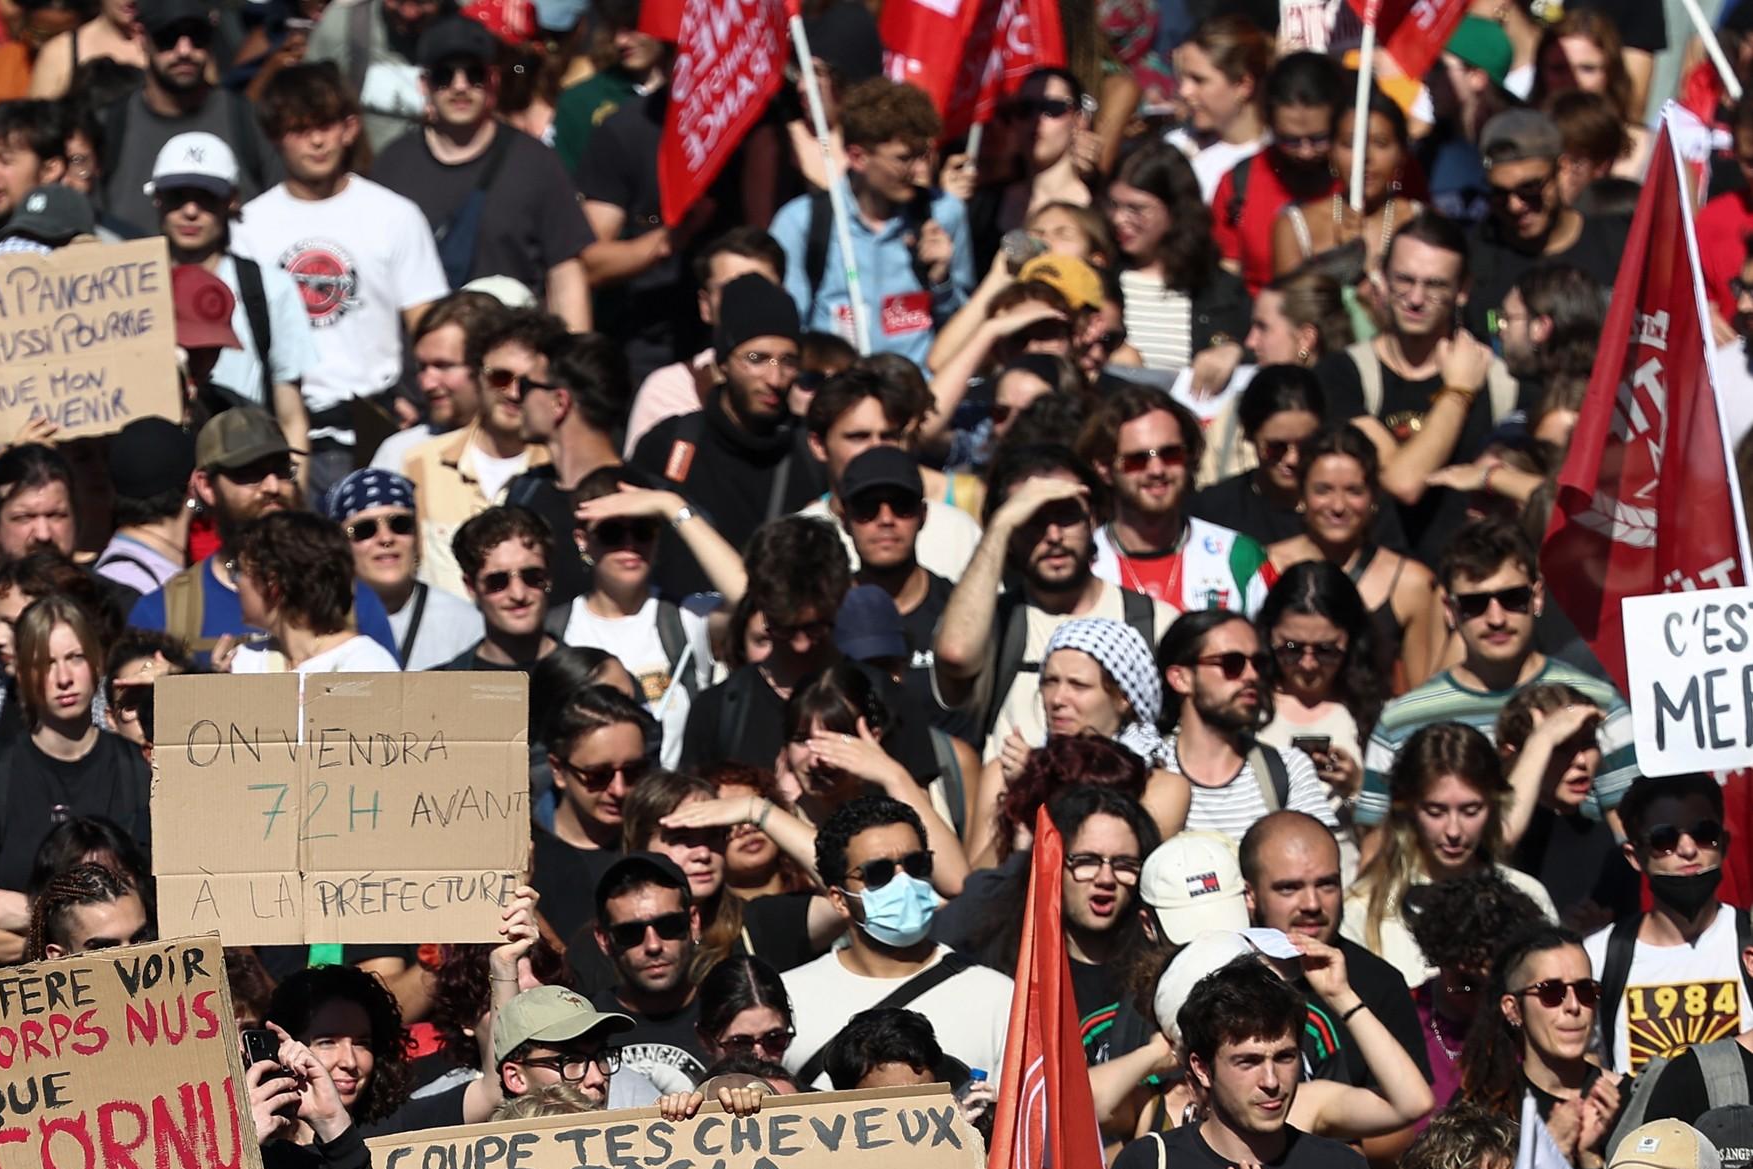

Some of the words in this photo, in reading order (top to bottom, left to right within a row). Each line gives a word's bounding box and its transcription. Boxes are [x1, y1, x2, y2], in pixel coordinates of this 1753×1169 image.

[6, 260, 160, 315] PANCARTE
[49, 366, 106, 398] MON
[1663, 602, 1753, 657] C'ES
[187, 719, 262, 767] ON
[410, 785, 530, 828] AVANT
[190, 865, 221, 921] À
[249, 874, 296, 919] LA
[313, 869, 519, 919] PRÉFECTURE
[125, 989, 222, 1048] NUS
[1628, 982, 1738, 1021] 1984
[554, 1117, 676, 1168] TES
[693, 1103, 964, 1157] CHEVEUX
